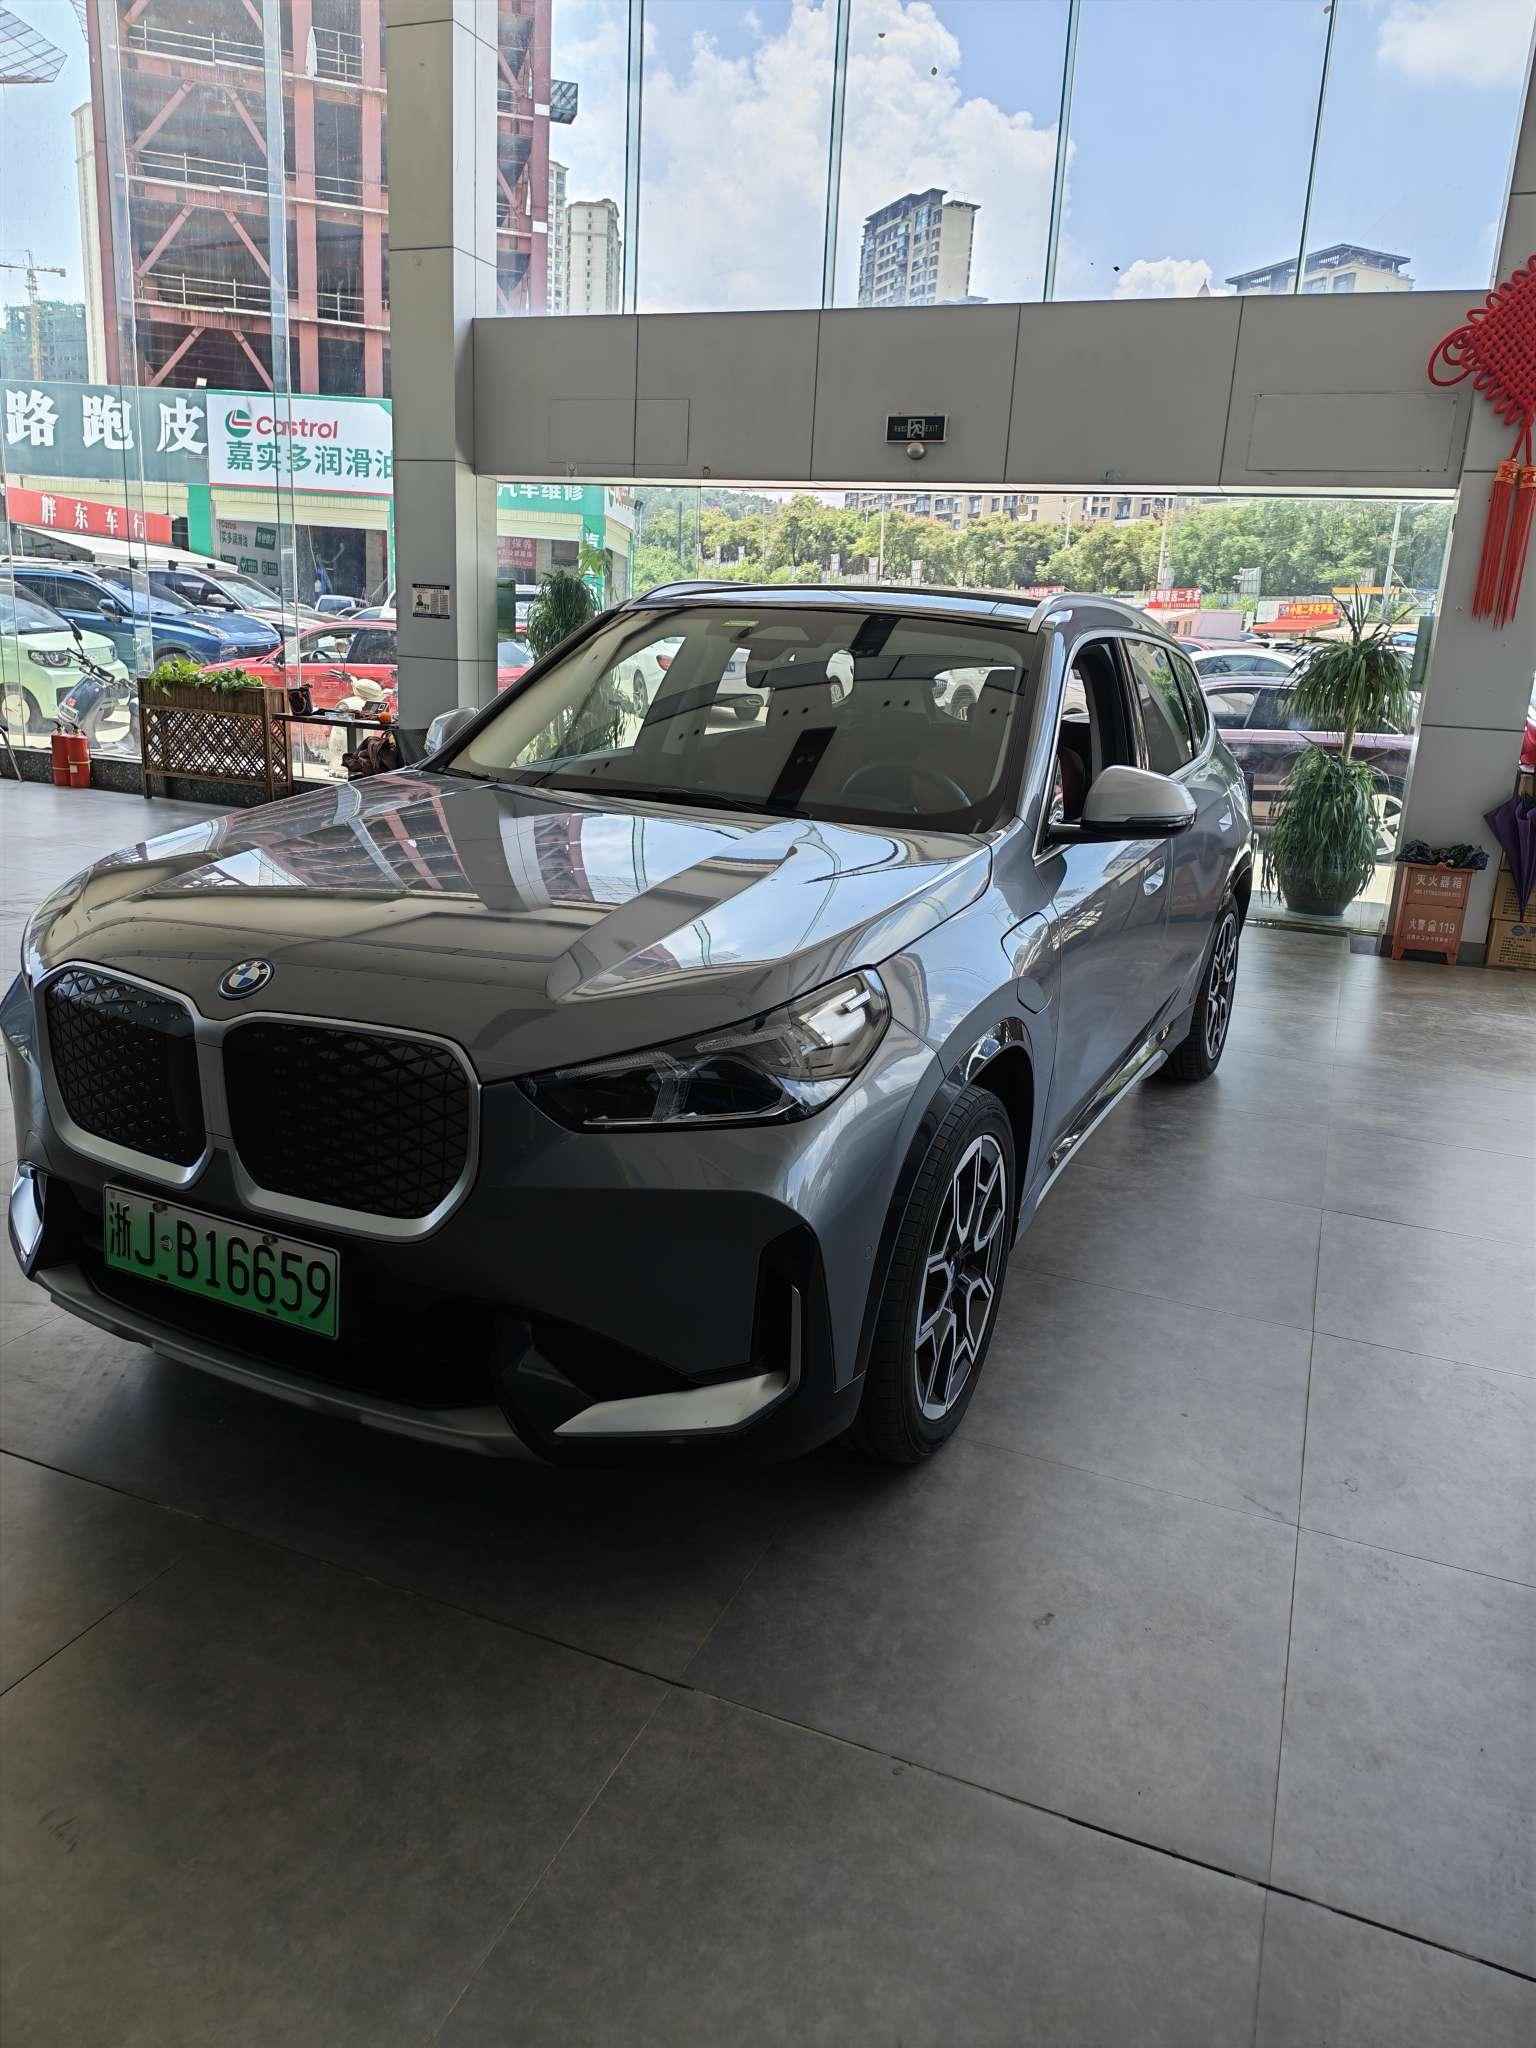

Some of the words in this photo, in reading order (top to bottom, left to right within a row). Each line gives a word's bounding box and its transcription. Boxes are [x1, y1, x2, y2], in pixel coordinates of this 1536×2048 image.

[6, 389, 207, 454] 路跑皮
[256, 415, 338, 439] Castrol
[925, 424, 938, 432] EXIT
[41, 494, 145, 538] 胖东车行
[1415, 874, 1463, 889] 灭火器箱
[1439, 921, 1455, 934] 119
